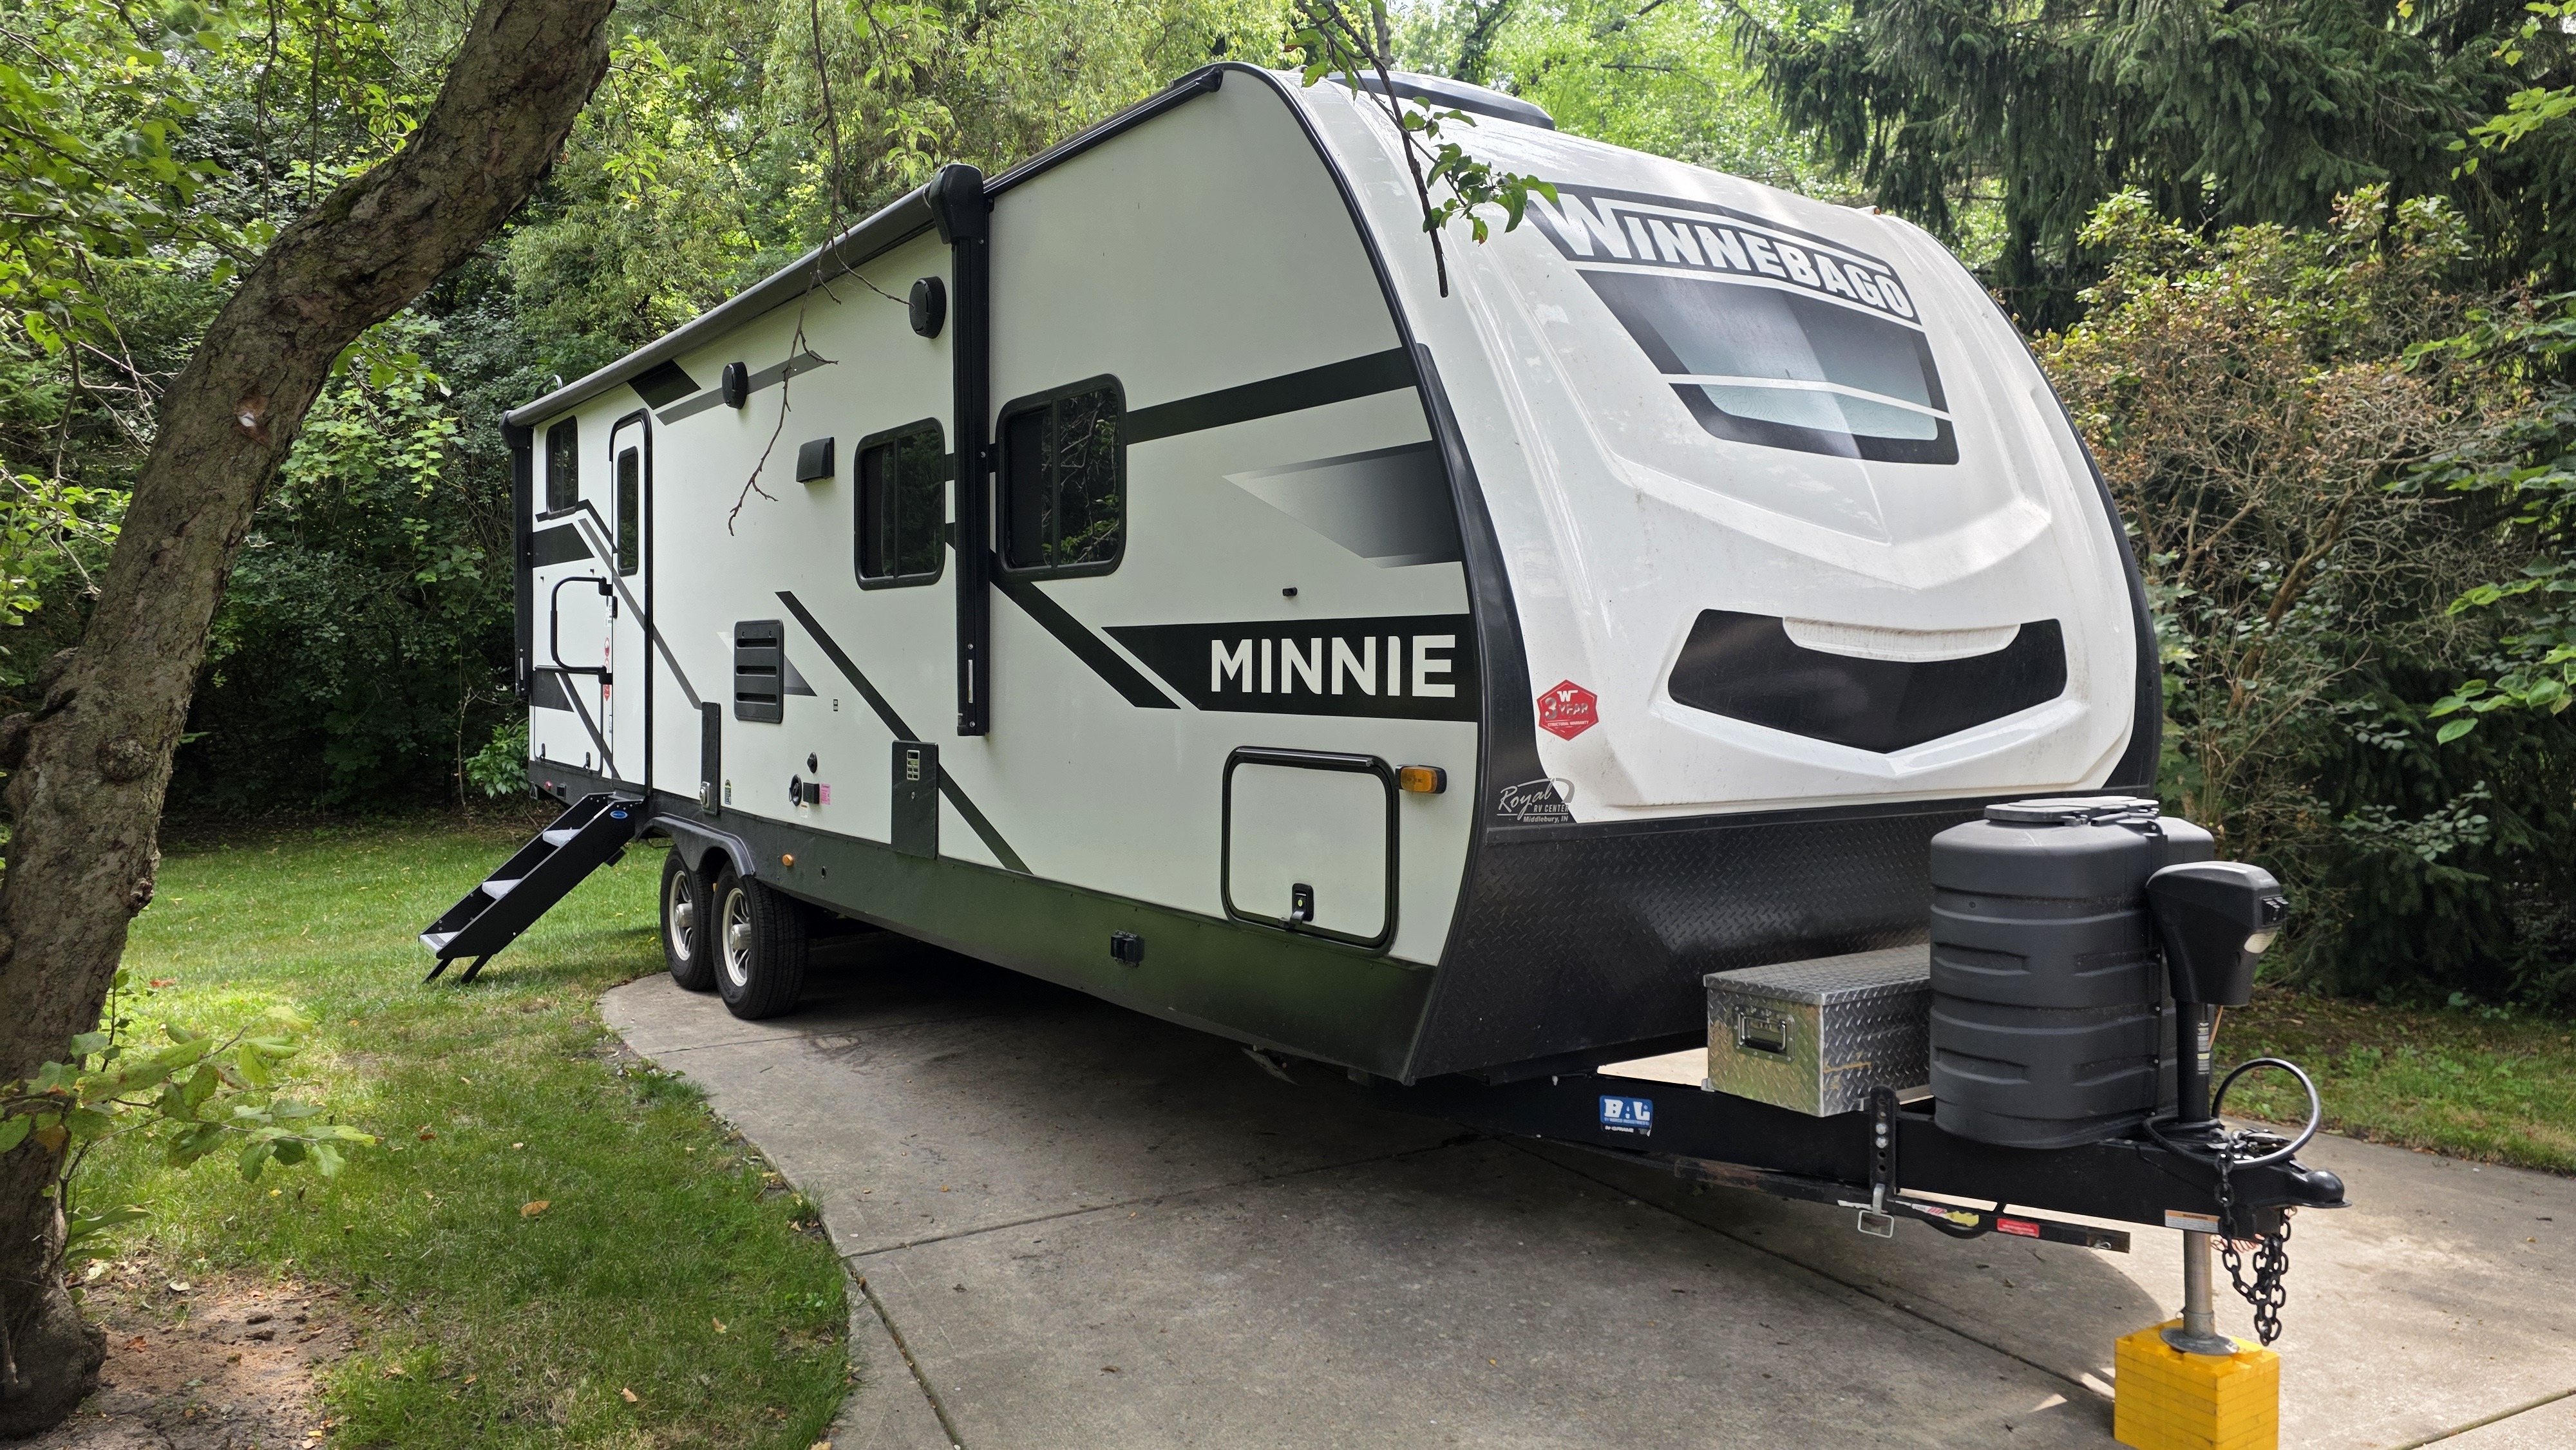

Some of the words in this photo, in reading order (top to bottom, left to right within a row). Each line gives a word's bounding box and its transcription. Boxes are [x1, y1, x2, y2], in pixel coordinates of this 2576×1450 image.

[1526, 190, 1913, 317] WINNEBAGO
[1211, 635, 1455, 697] MINNIE
[1545, 697, 1558, 719] 3
[1558, 703, 1588, 715] YEAR
[1498, 778, 1555, 821] Royal
[1604, 1098, 1650, 1120] BAL
